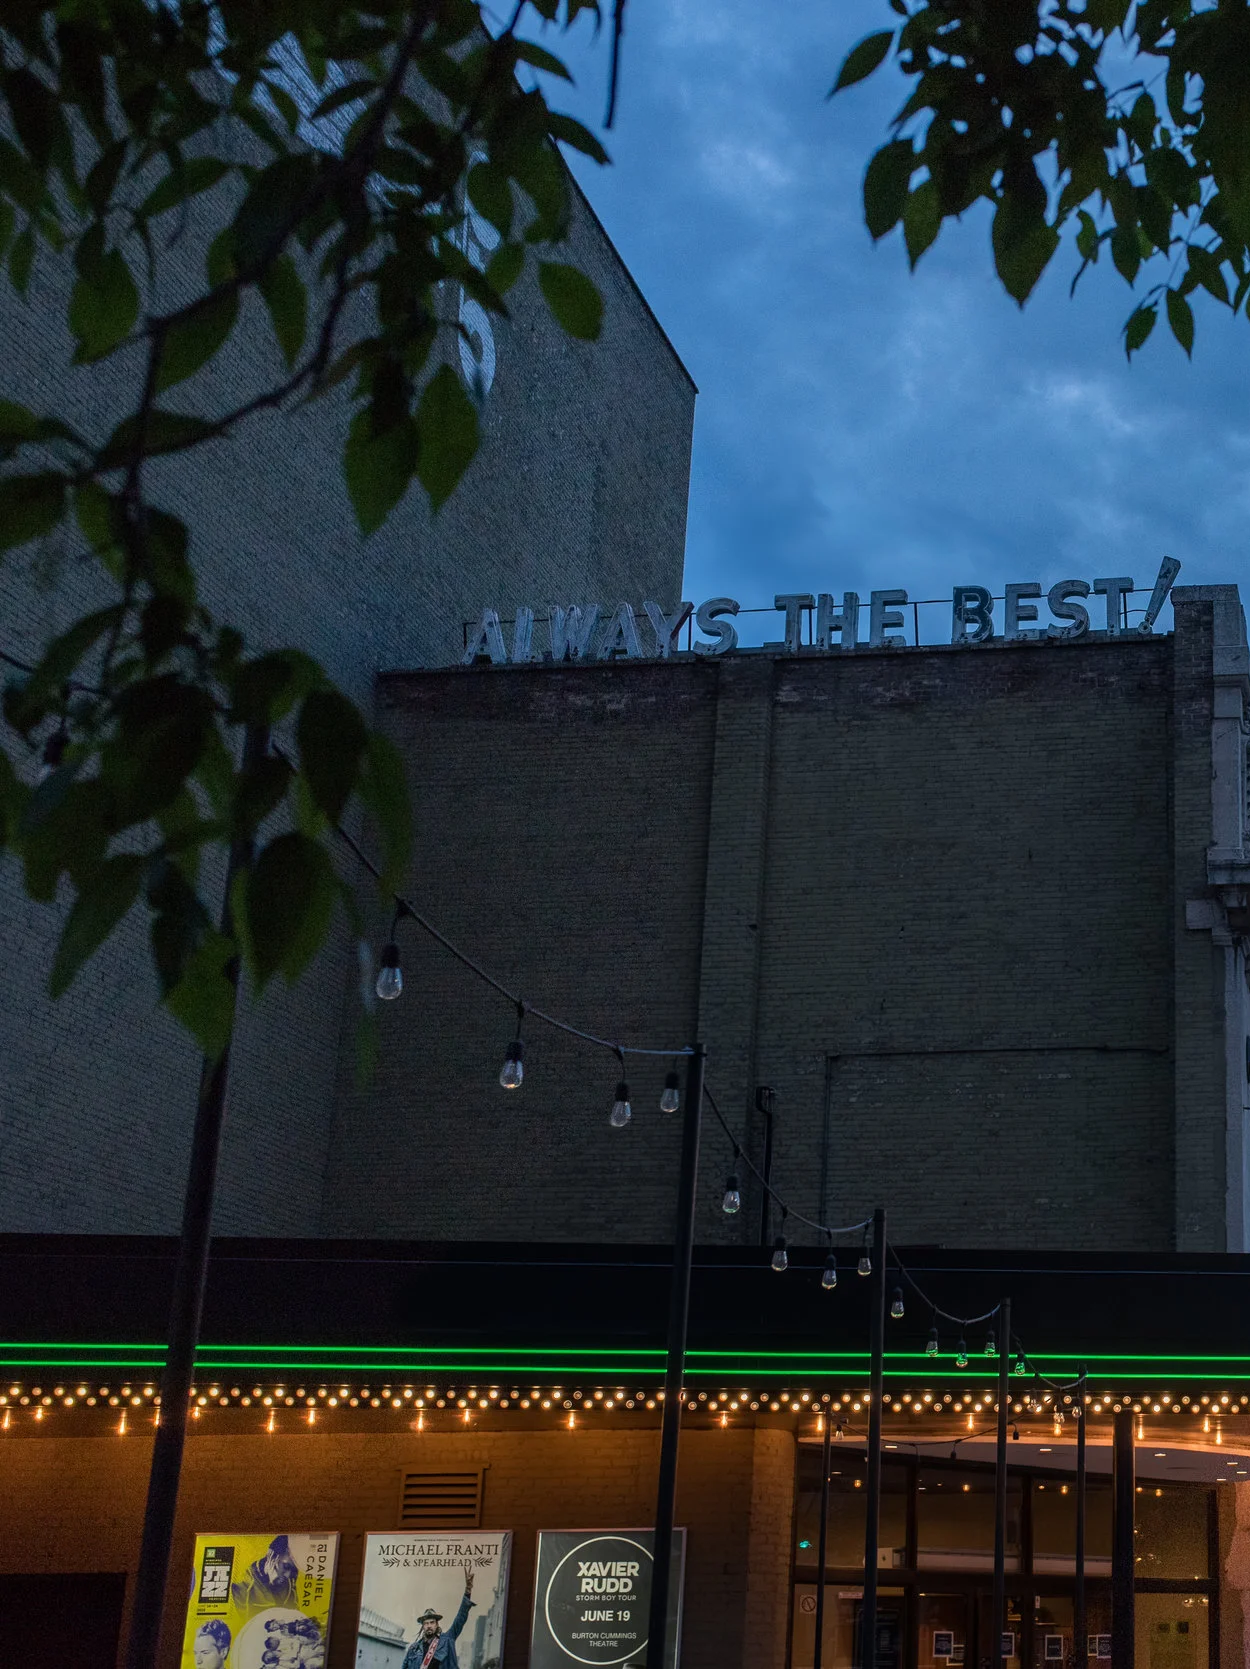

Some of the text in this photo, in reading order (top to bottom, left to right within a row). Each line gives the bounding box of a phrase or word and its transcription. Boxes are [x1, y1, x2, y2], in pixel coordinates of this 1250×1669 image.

[466, 555, 1181, 665] ALWAYS THE BEST!
[317, 1544, 327, 1552] 21
[378, 1544, 499, 1556] MICHAEL FRANTI
[403, 1558, 471, 1567] & SPEARHEAD
[577, 1561, 640, 1577] XAVIER
[302, 1556, 314, 1607] CAESAR
[314, 1556, 326, 1602] DANIEL
[581, 1578, 633, 1593] RUDD
[580, 1610, 631, 1621] JUNE 19
[571, 1632, 637, 1640] BURTON CUMMINGS
[589, 1640, 618, 1648] THEATRE
